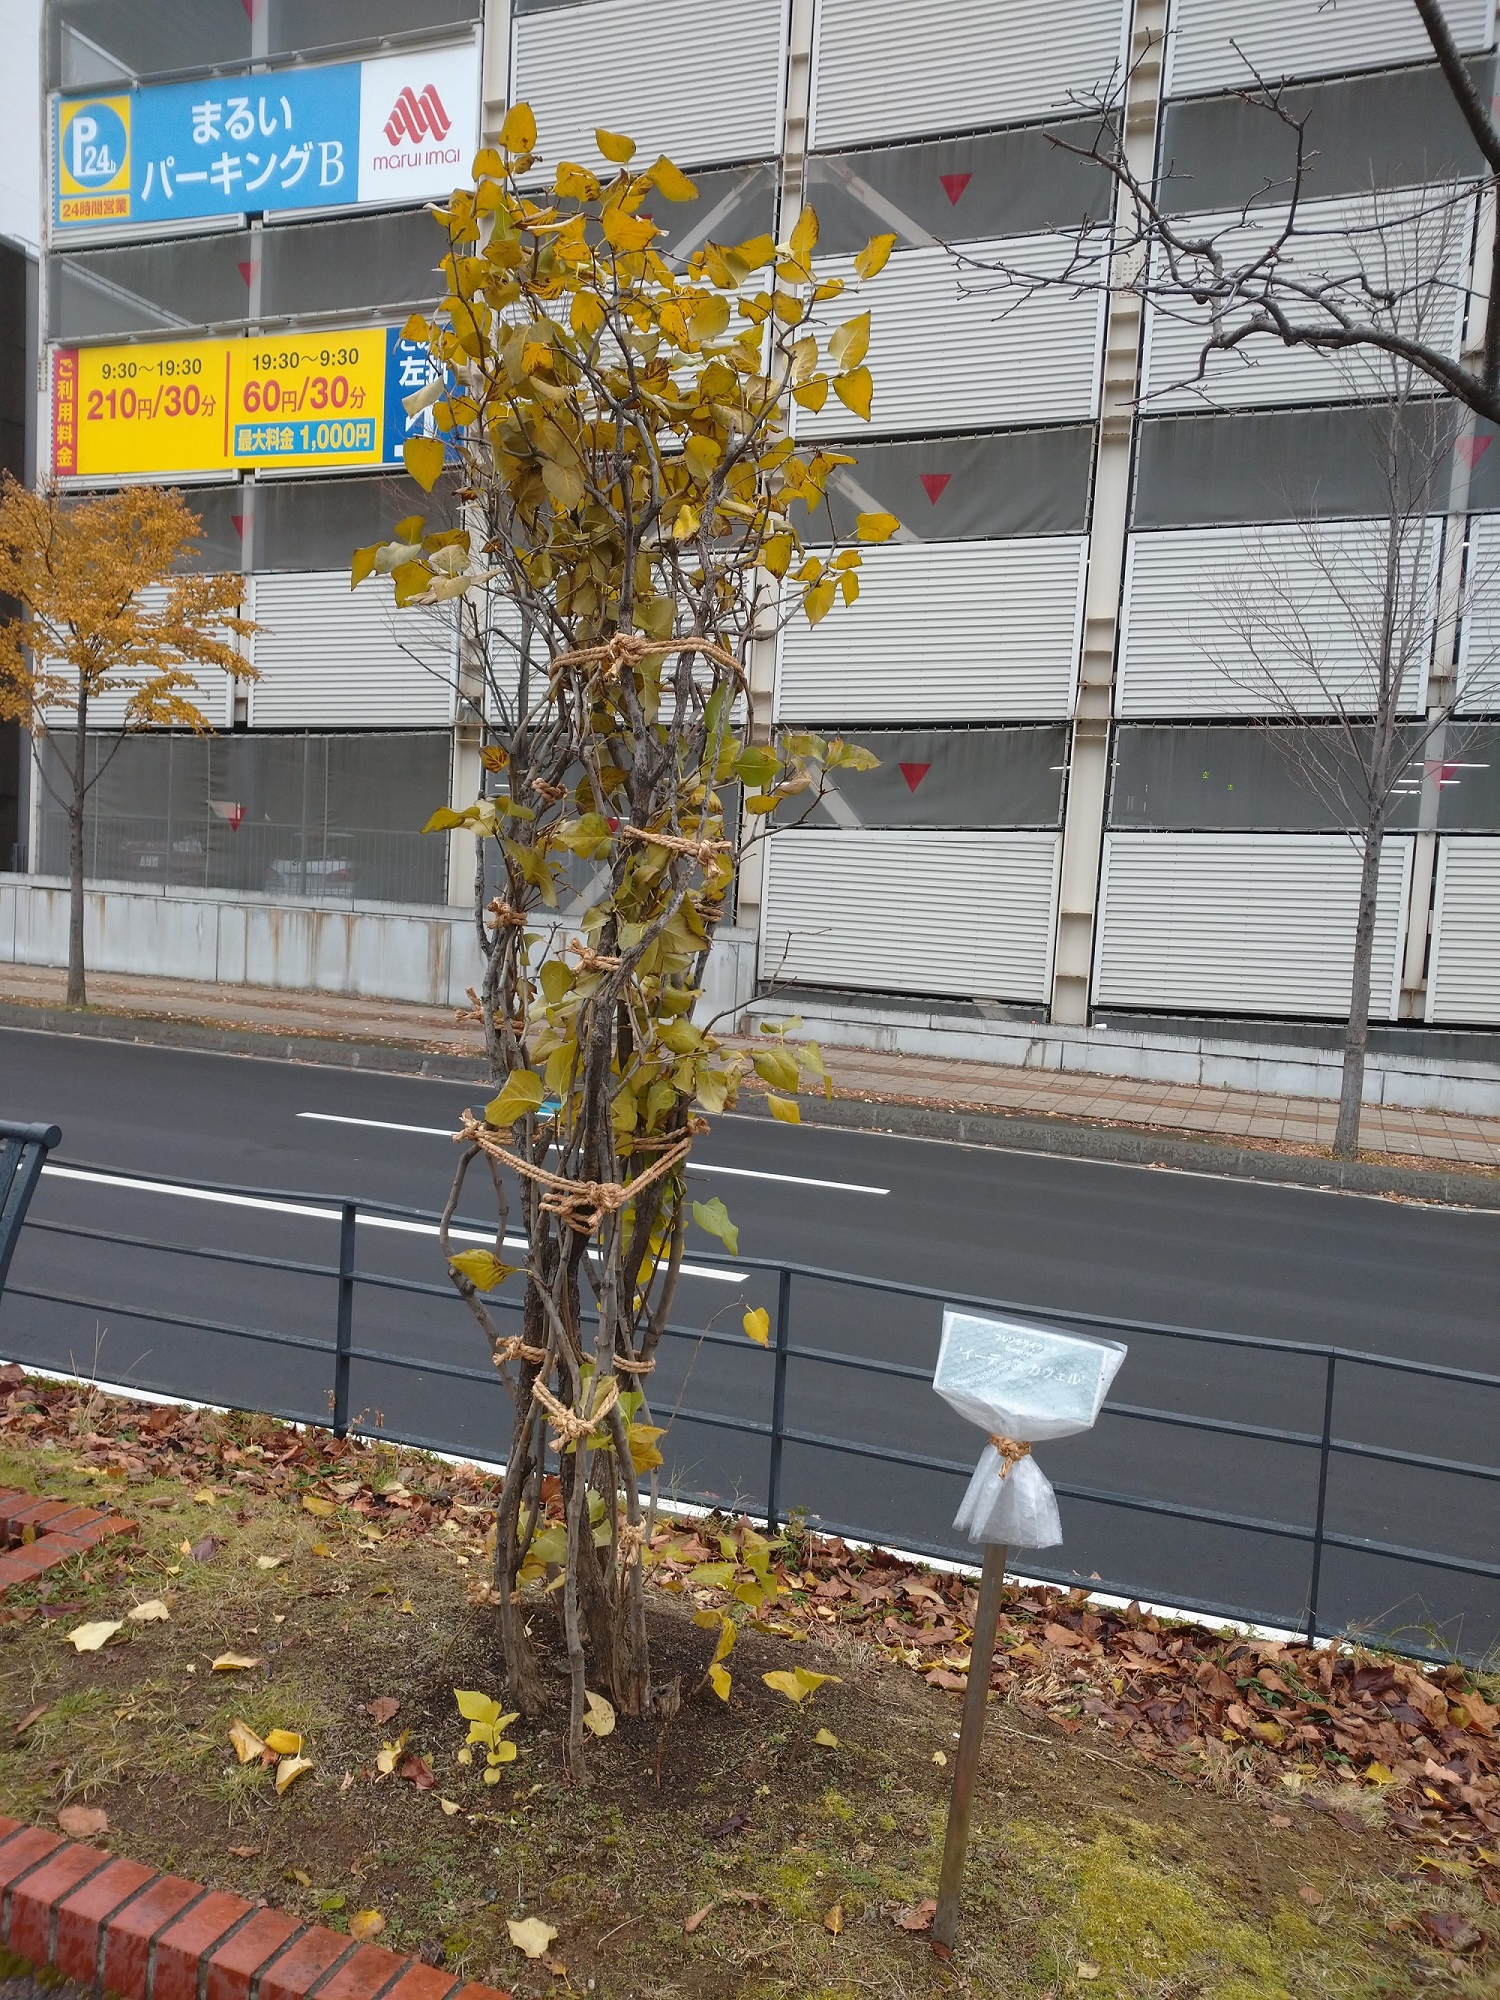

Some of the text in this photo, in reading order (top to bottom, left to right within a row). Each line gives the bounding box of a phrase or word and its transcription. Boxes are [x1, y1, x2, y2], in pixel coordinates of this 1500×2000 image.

[191, 95, 293, 144] まるい
[373, 148, 460, 171] marui imai
[62, 197, 127, 218] 24時間営業
[56, 358, 73, 467] ご利用料金
[86, 383, 217, 421] 210円/30分
[242, 375, 367, 413] 60円/30分
[237, 422, 371, 452] 最大料金 1,000円
